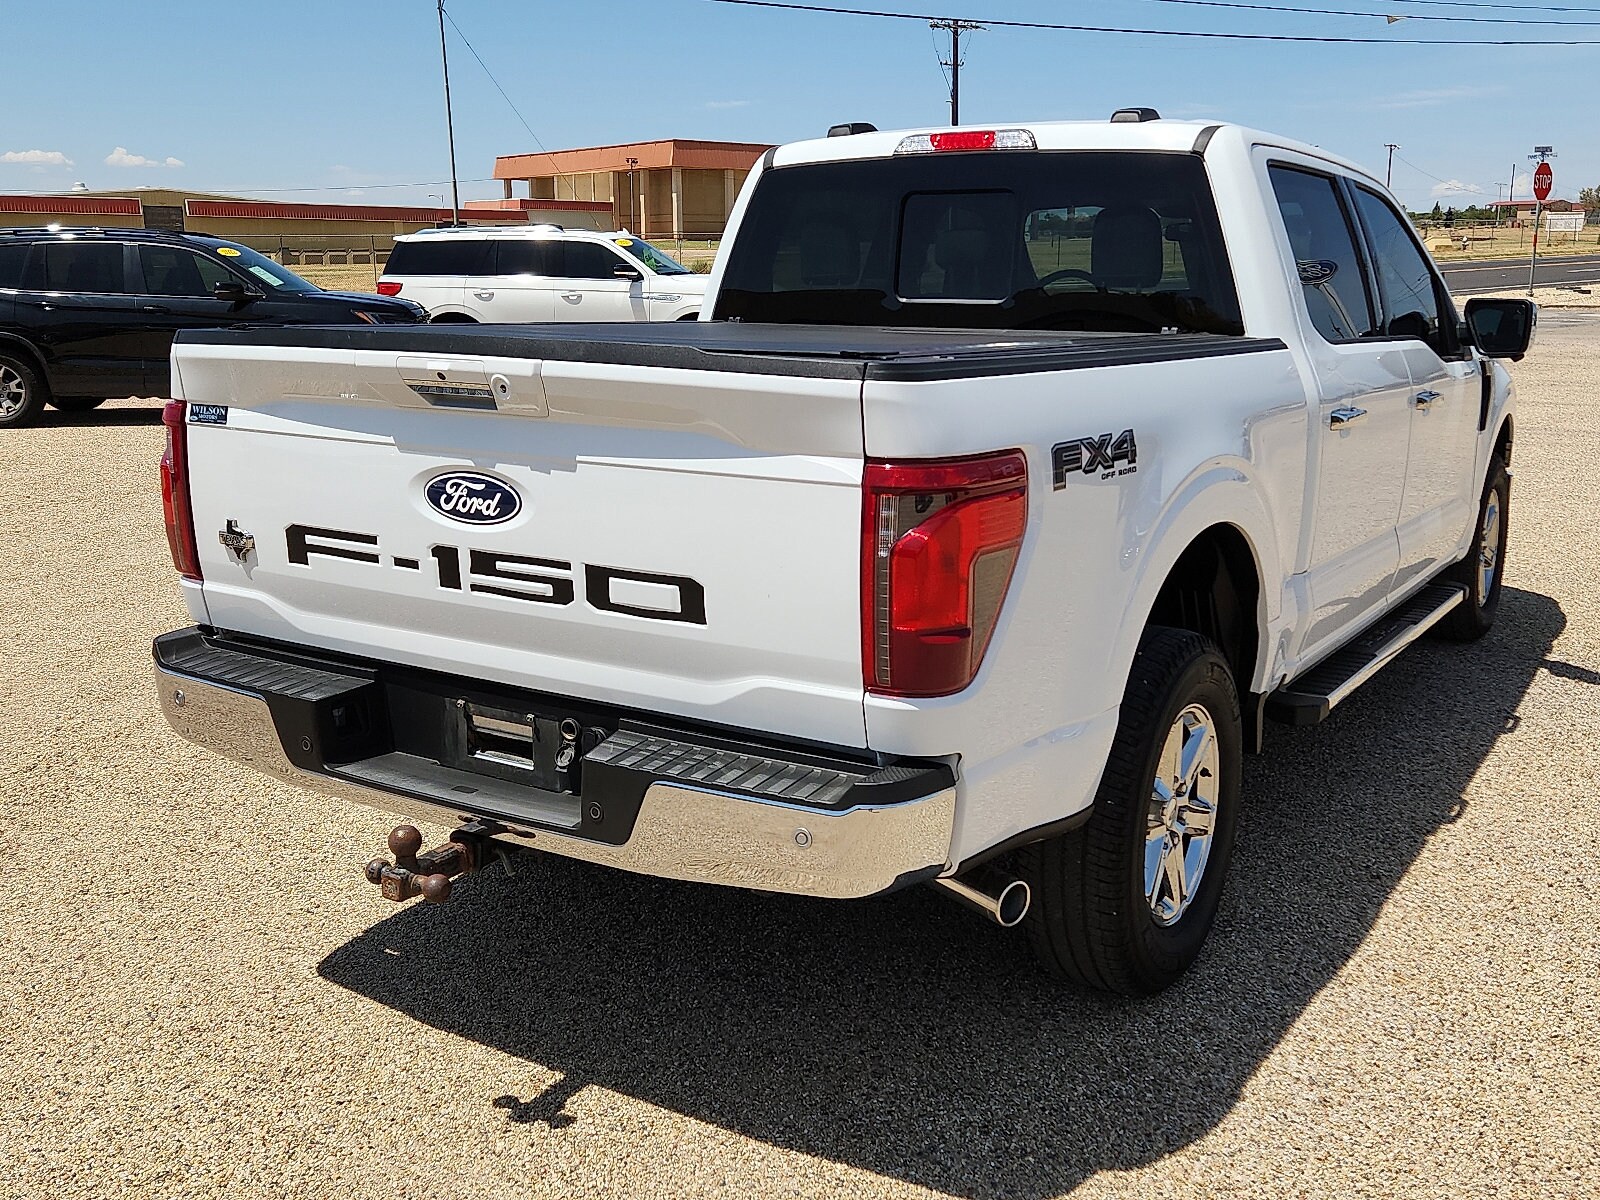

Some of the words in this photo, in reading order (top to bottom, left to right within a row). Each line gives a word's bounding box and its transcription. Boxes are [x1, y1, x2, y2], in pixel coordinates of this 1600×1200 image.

[1534, 174, 1552, 189] STOP
[192, 405, 226, 415] WILSON
[1050, 428, 1137, 491] FX4
[1101, 470, 1116, 481] OFF
[1118, 466, 1137, 477] ROAD
[440, 478, 501, 517] Ford
[284, 523, 708, 627] F-150
